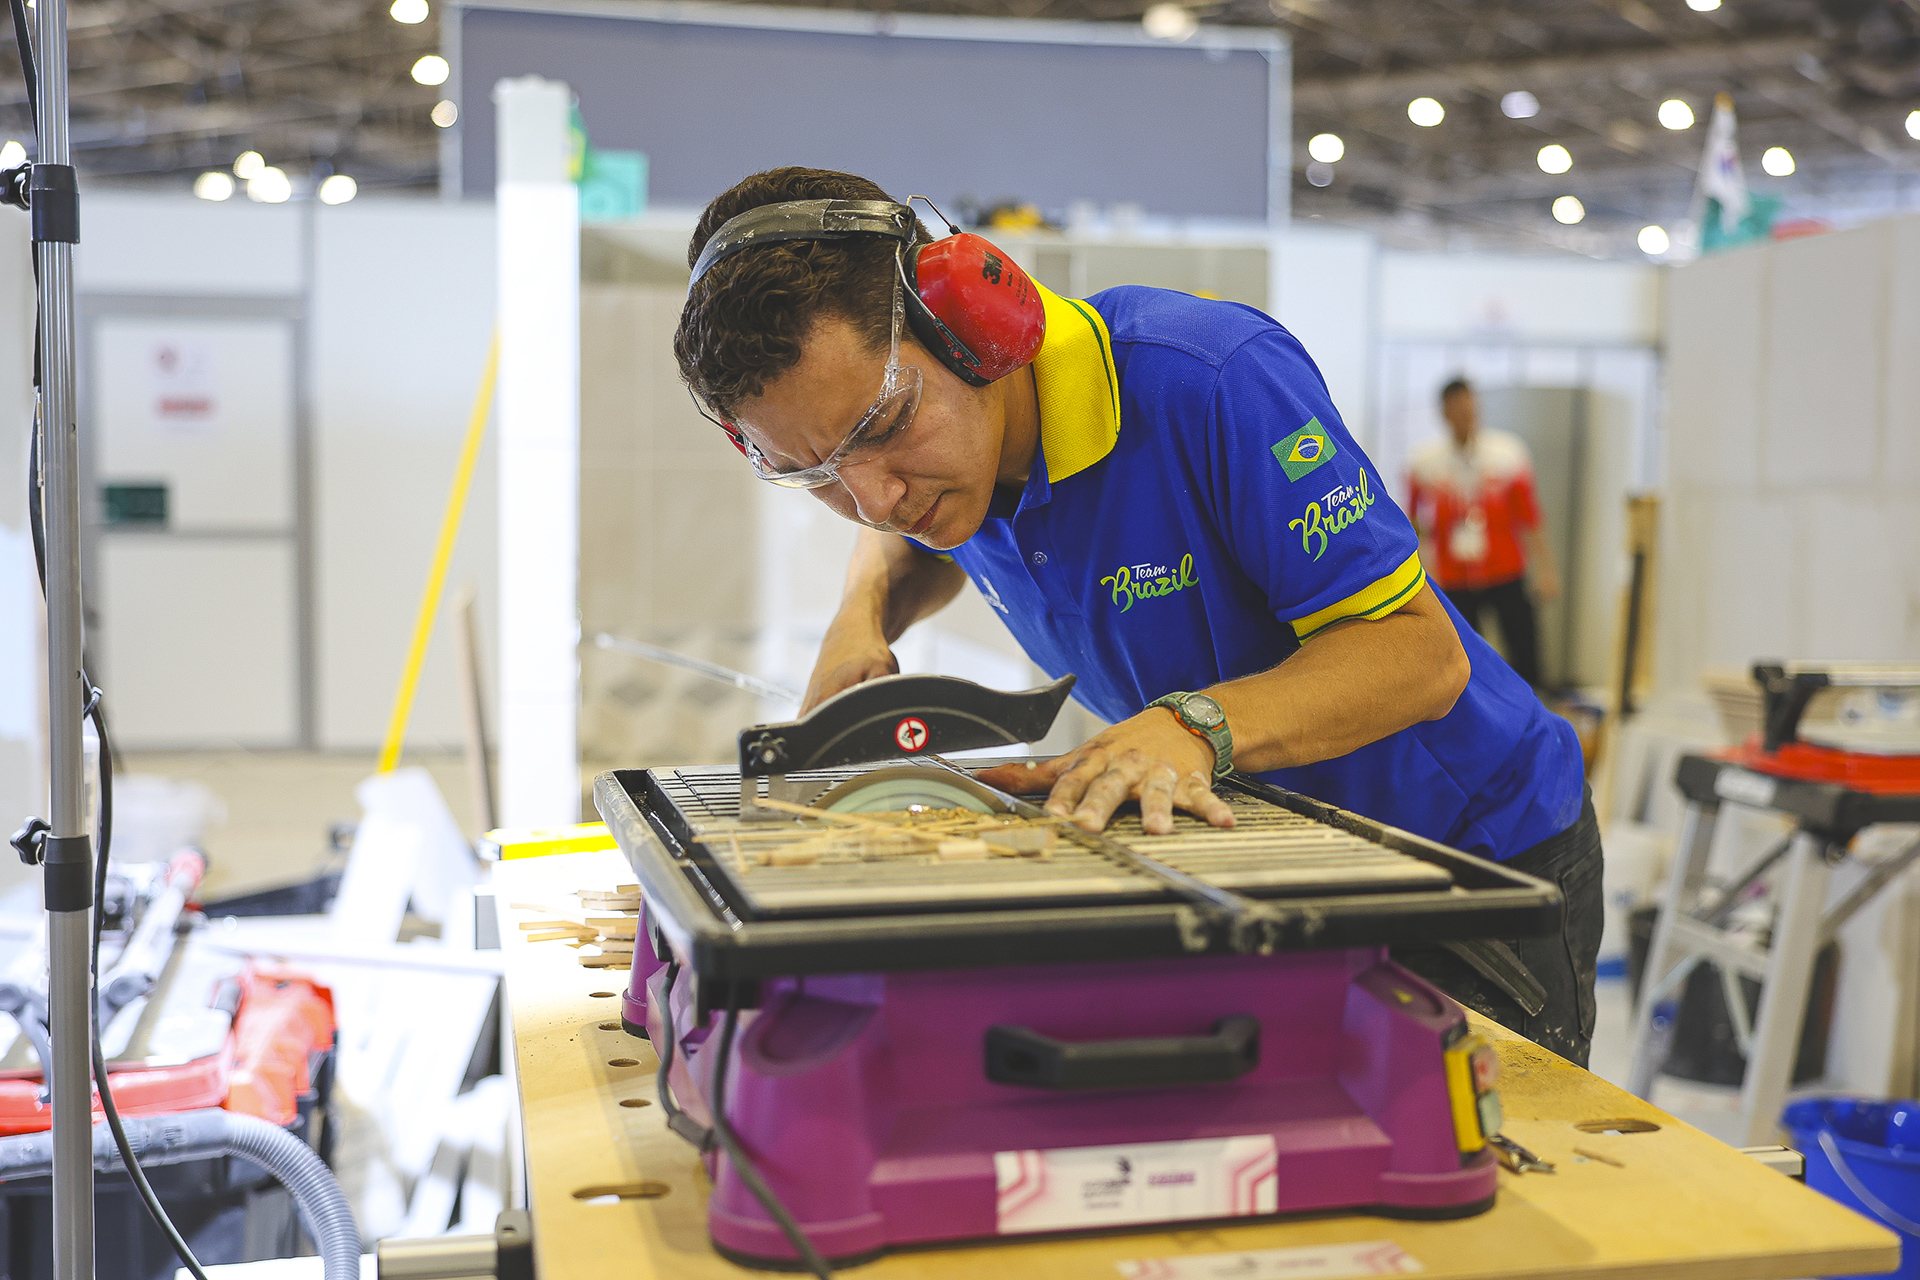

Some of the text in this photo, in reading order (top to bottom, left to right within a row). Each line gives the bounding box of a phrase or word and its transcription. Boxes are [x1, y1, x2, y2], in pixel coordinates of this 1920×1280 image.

[982, 251, 1003, 285] 3M
[1288, 467, 1375, 563] Brazil
[1320, 485, 1354, 512] Team
[1100, 553, 1199, 613] Brazil
[1131, 563, 1168, 580] Team
